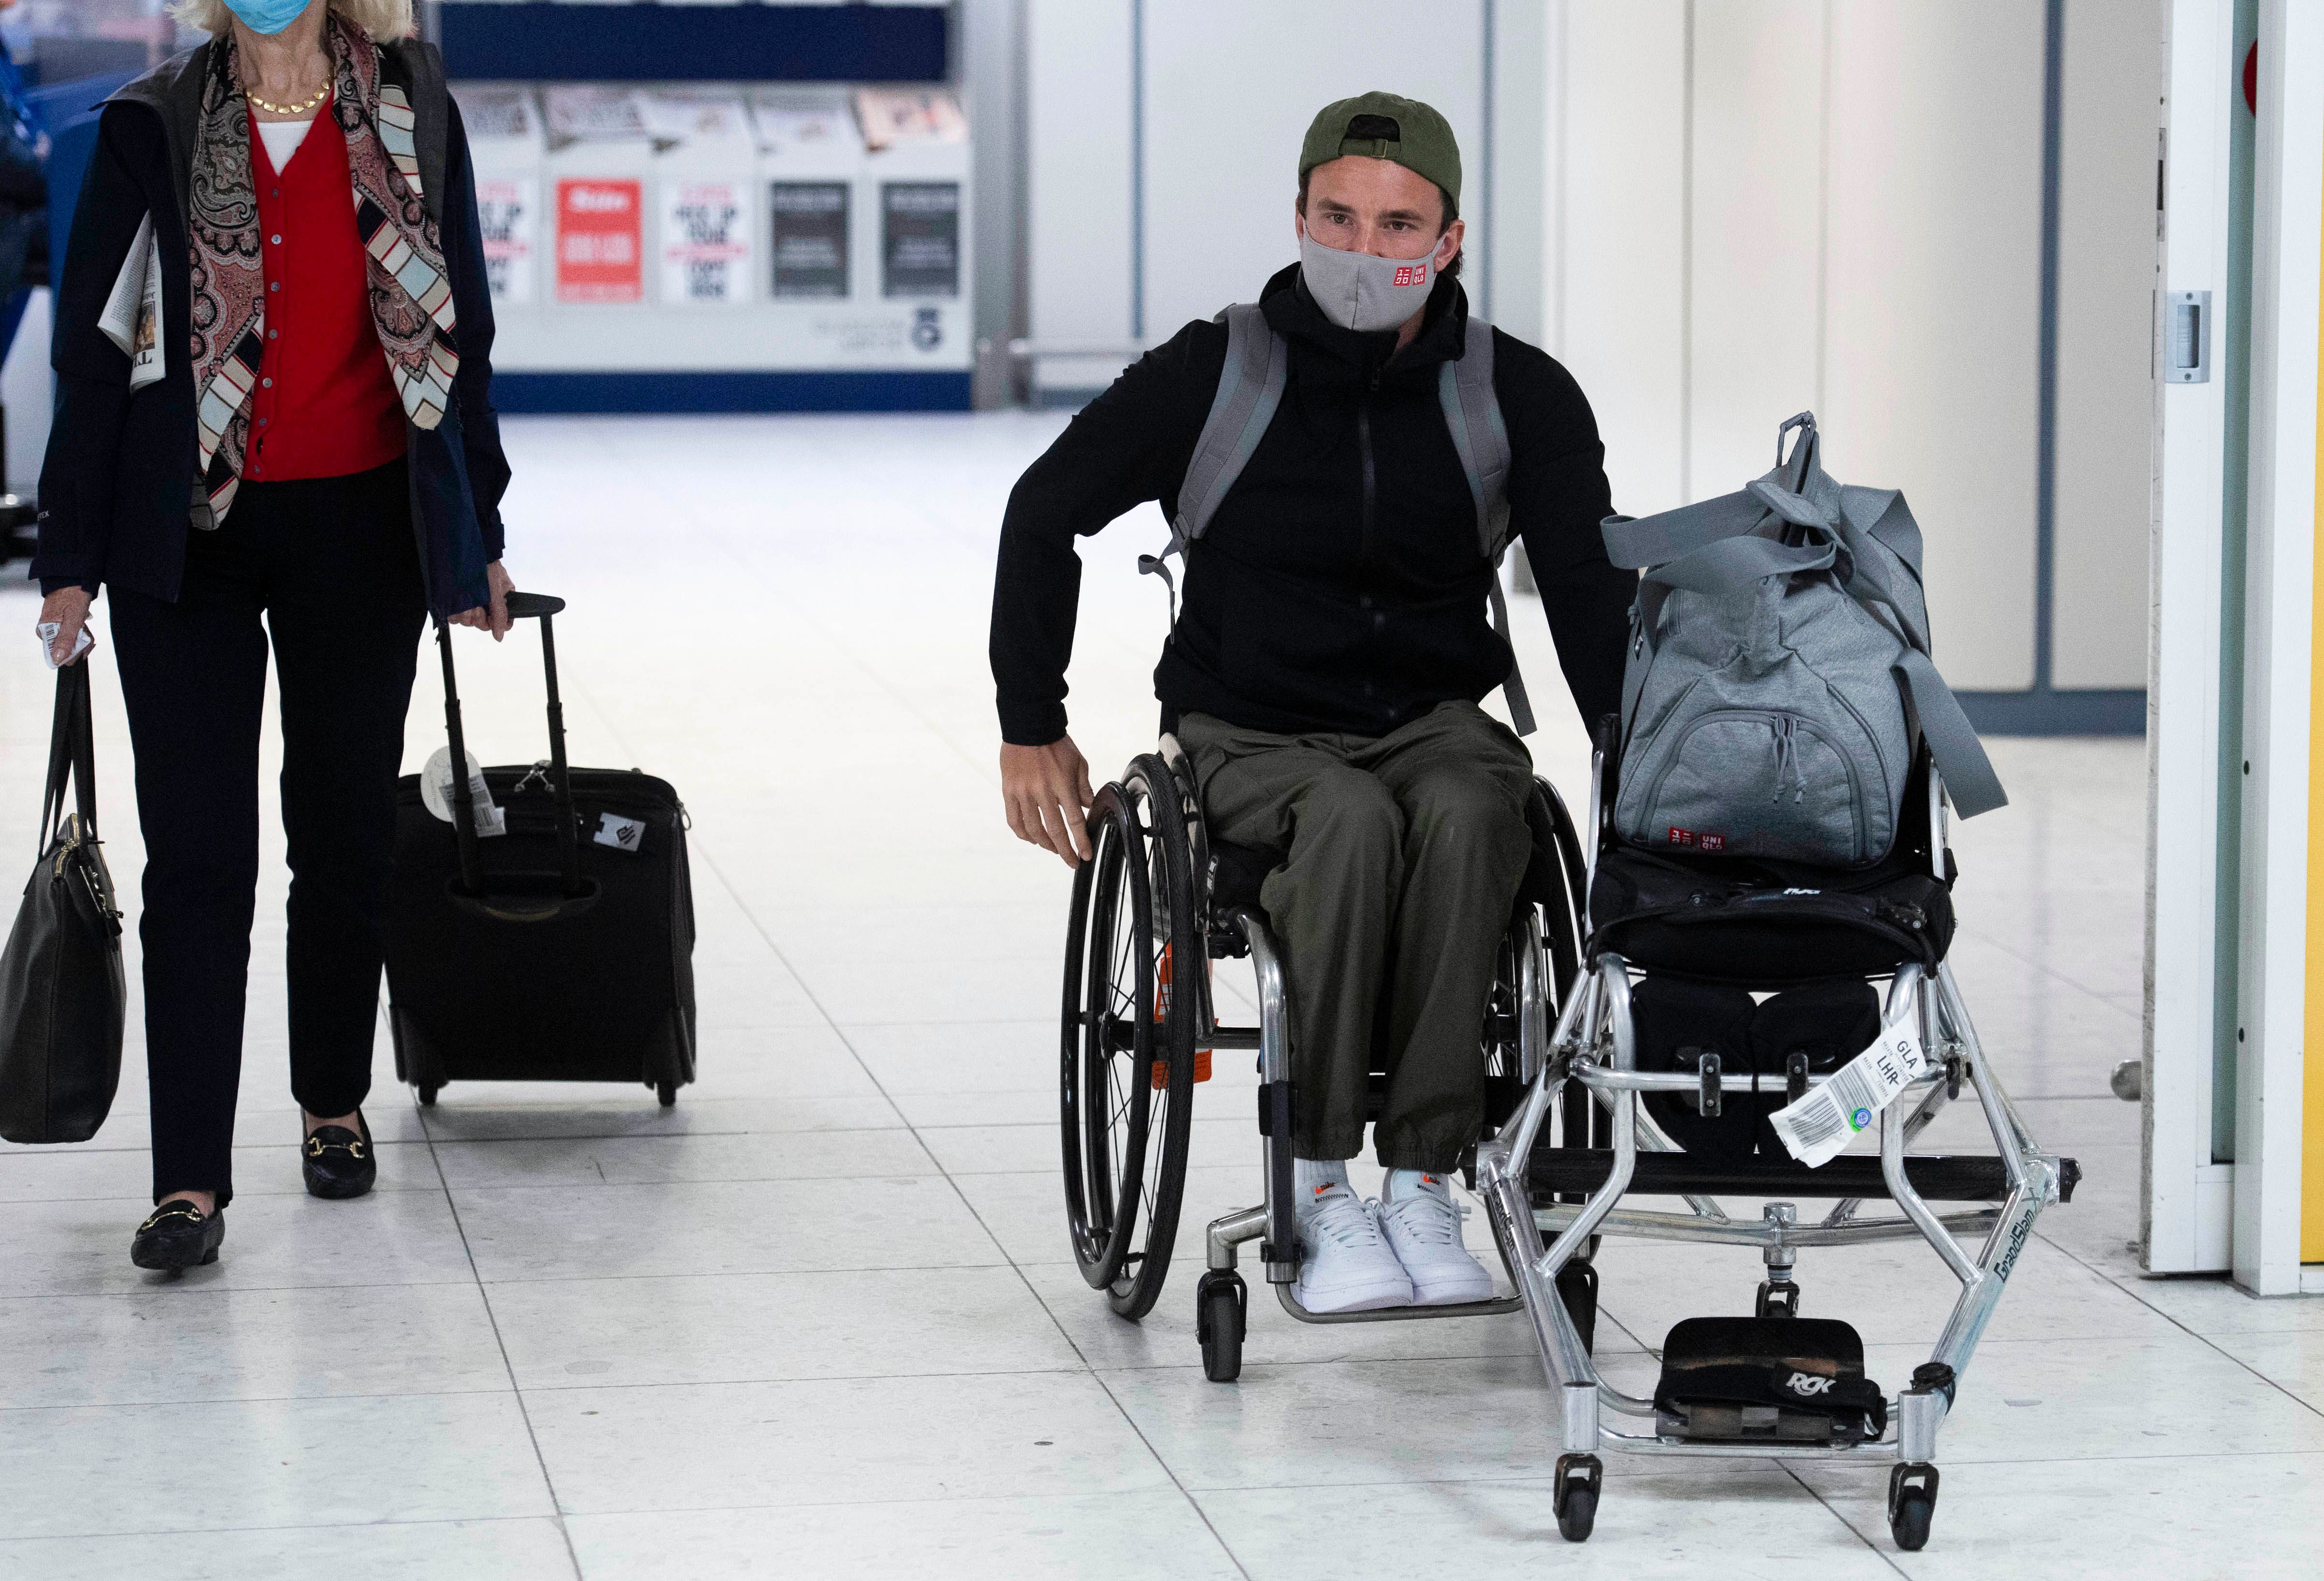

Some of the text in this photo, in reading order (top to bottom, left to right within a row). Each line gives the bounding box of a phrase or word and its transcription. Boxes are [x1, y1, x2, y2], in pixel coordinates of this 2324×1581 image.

[1414, 275, 1424, 284] QLO
[1415, 266, 1424, 274] UNI
[1703, 835, 1721, 844] UNI
[1897, 1041, 1917, 1069] GLA
[1877, 1055, 1898, 1085] LHR
[1994, 1209, 2035, 1283] GrandSlam
[1785, 1372, 1837, 1396] RGK
